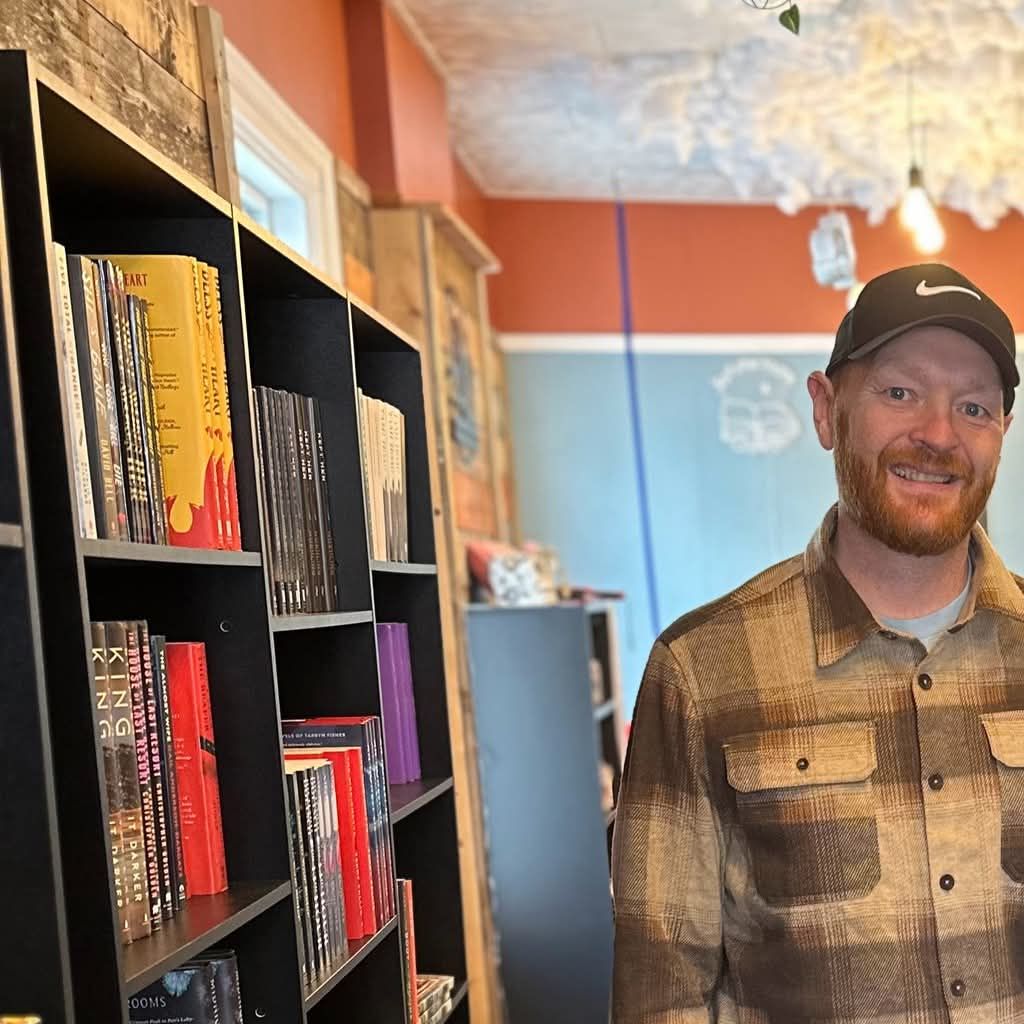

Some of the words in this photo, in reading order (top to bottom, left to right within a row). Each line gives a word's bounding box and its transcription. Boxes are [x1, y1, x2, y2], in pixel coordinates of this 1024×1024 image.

[124, 273, 147, 287] EART
[128, 648, 140, 689] HOUSE
[142, 645, 154, 685] HOUSE
[91, 647, 113, 739] KING
[107, 647, 131, 737] KING
[160, 672, 171, 715] ALMOST
[133, 703, 146, 735] LAST
[147, 699, 157, 728] LAST
[164, 716, 172, 743] WIFE
[136, 737, 149, 785] RESORT
[149, 732, 162, 777] RESORT
[127, 815, 138, 831] IT
[129, 840, 143, 902] DARKER
